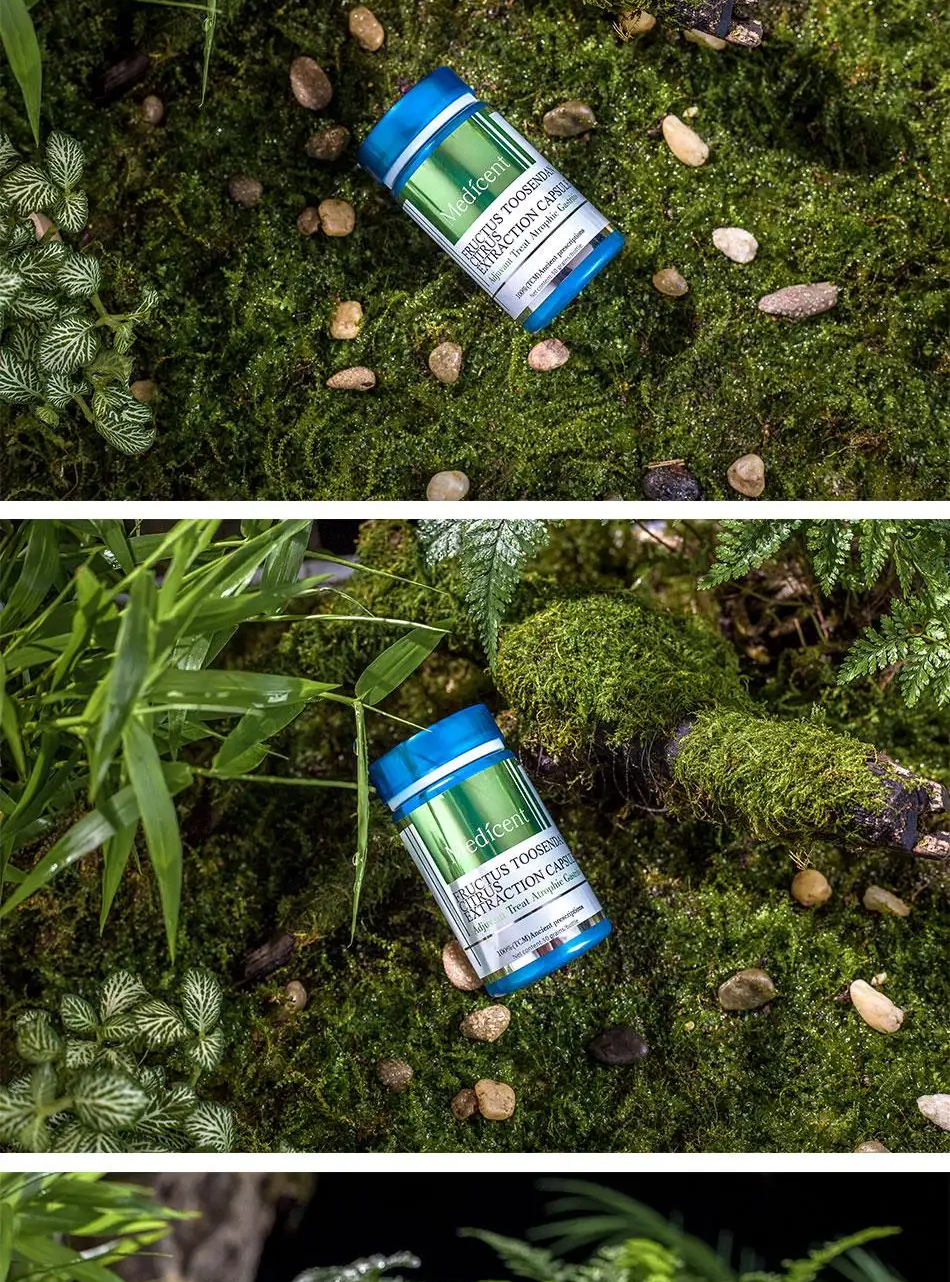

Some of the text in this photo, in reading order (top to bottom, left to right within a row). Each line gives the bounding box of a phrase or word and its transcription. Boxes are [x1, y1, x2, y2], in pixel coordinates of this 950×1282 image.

[461, 213, 504, 260] FRUCTUS
[469, 230, 502, 268] CITRUS
[477, 208, 540, 275] EXTRACTION
[510, 239, 531, 258] Treat
[530, 211, 560, 240] Atrophic
[453, 863, 510, 904] FRUCTUS
[459, 881, 504, 914] CITRUS
[464, 870, 546, 923] EXTRACTION
[506, 898, 530, 915] Treat
[531, 879, 564, 902] Atrophic
